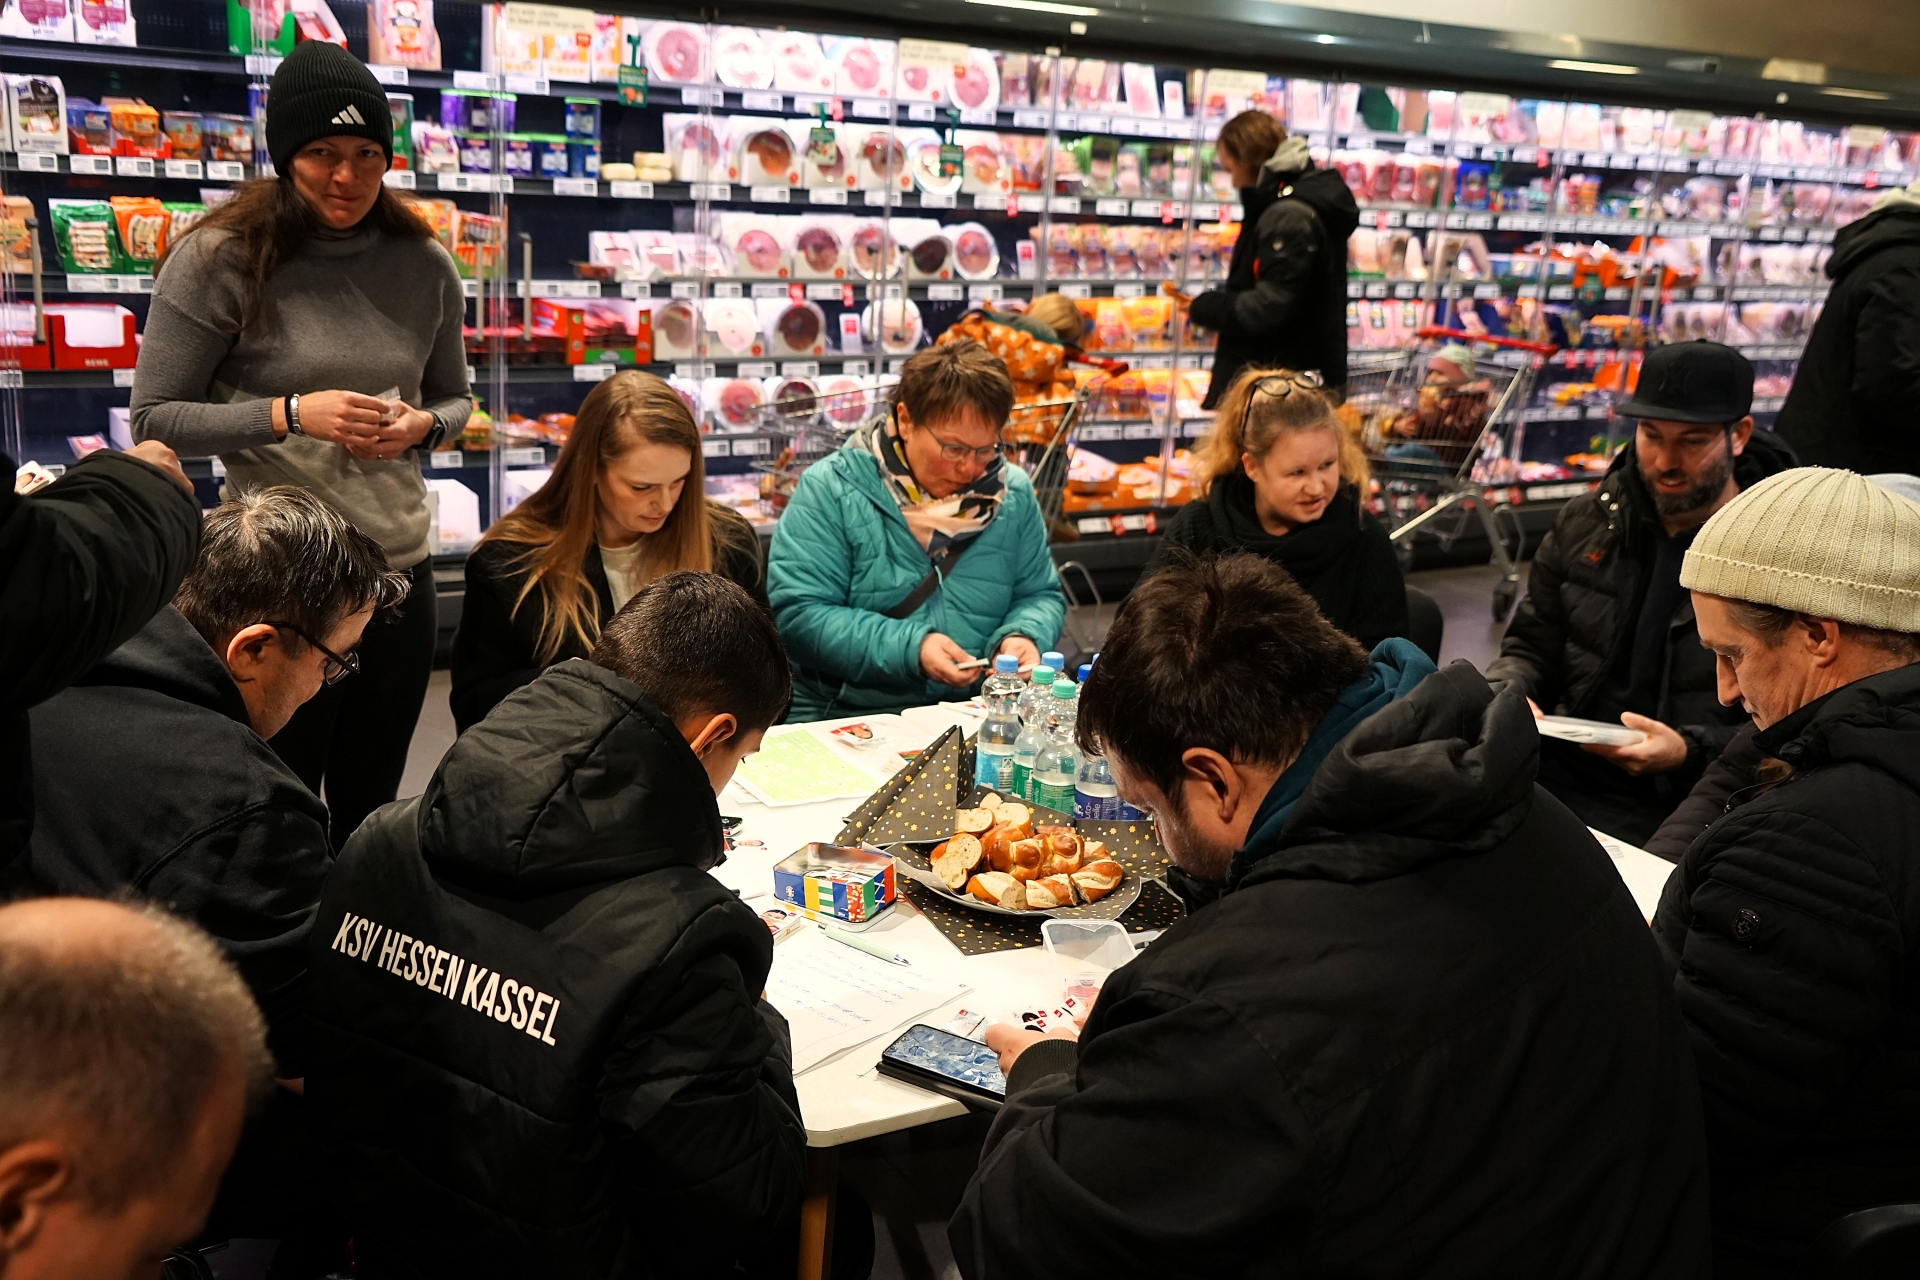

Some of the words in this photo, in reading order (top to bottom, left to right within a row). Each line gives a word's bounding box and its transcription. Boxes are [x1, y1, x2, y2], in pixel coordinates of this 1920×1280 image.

[331, 911, 383, 963] KSV
[377, 927, 465, 1001] HESSEN
[460, 963, 561, 1047] KASSEL
